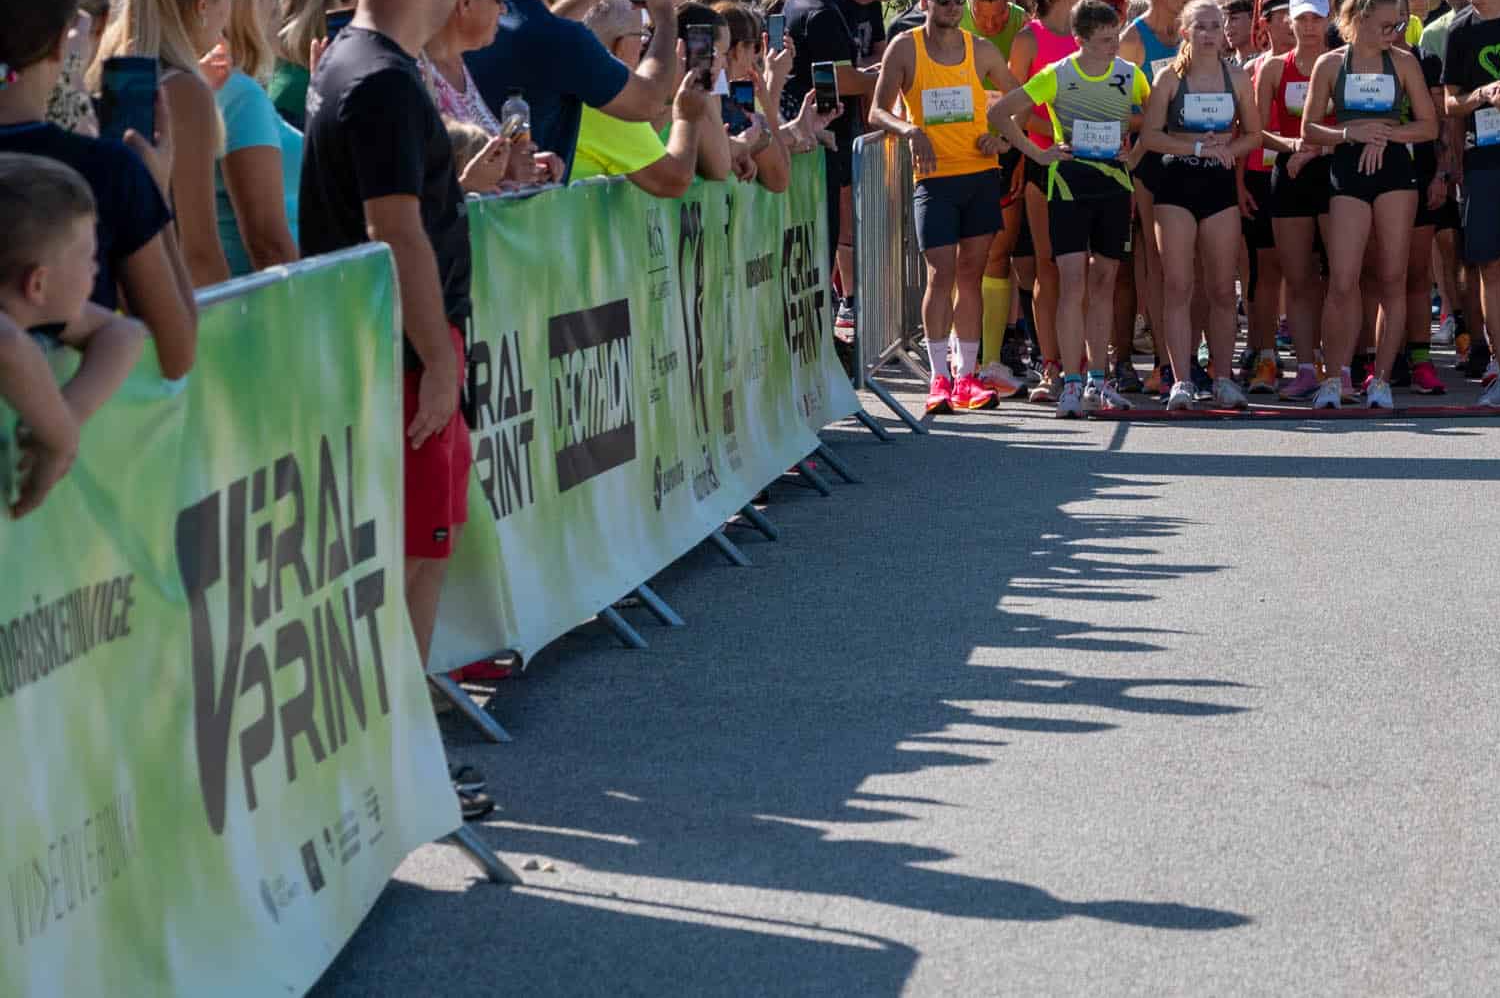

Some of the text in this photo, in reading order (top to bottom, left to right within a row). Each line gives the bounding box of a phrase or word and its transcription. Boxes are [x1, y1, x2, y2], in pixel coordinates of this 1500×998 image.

[551, 335, 635, 454] DECATHLON
[476, 418, 535, 521] RINT
[238, 568, 390, 813] PRINT
